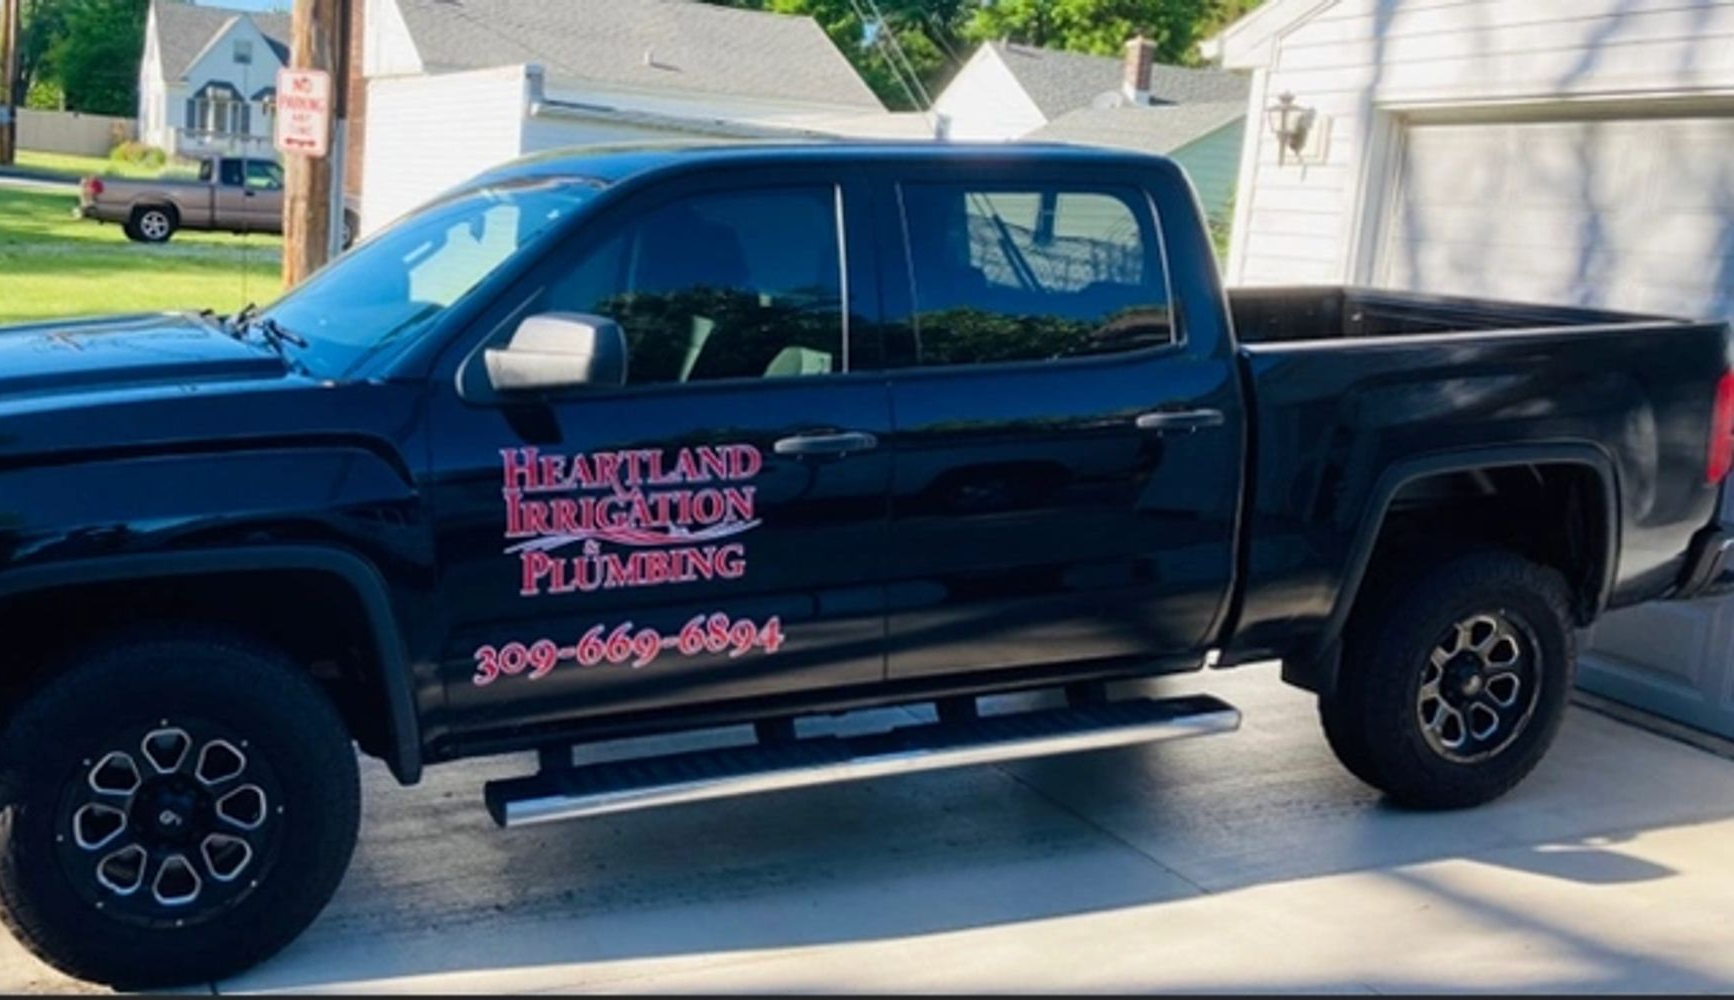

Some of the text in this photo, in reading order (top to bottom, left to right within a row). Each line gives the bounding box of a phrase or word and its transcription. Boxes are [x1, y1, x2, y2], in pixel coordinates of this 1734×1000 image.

[292, 77, 313, 93] NO
[499, 444, 763, 499] HEARTLAND
[503, 486, 756, 538] IRRIGATION
[520, 543, 746, 596] PLUMBING
[472, 611, 785, 686] 309-669-6894
